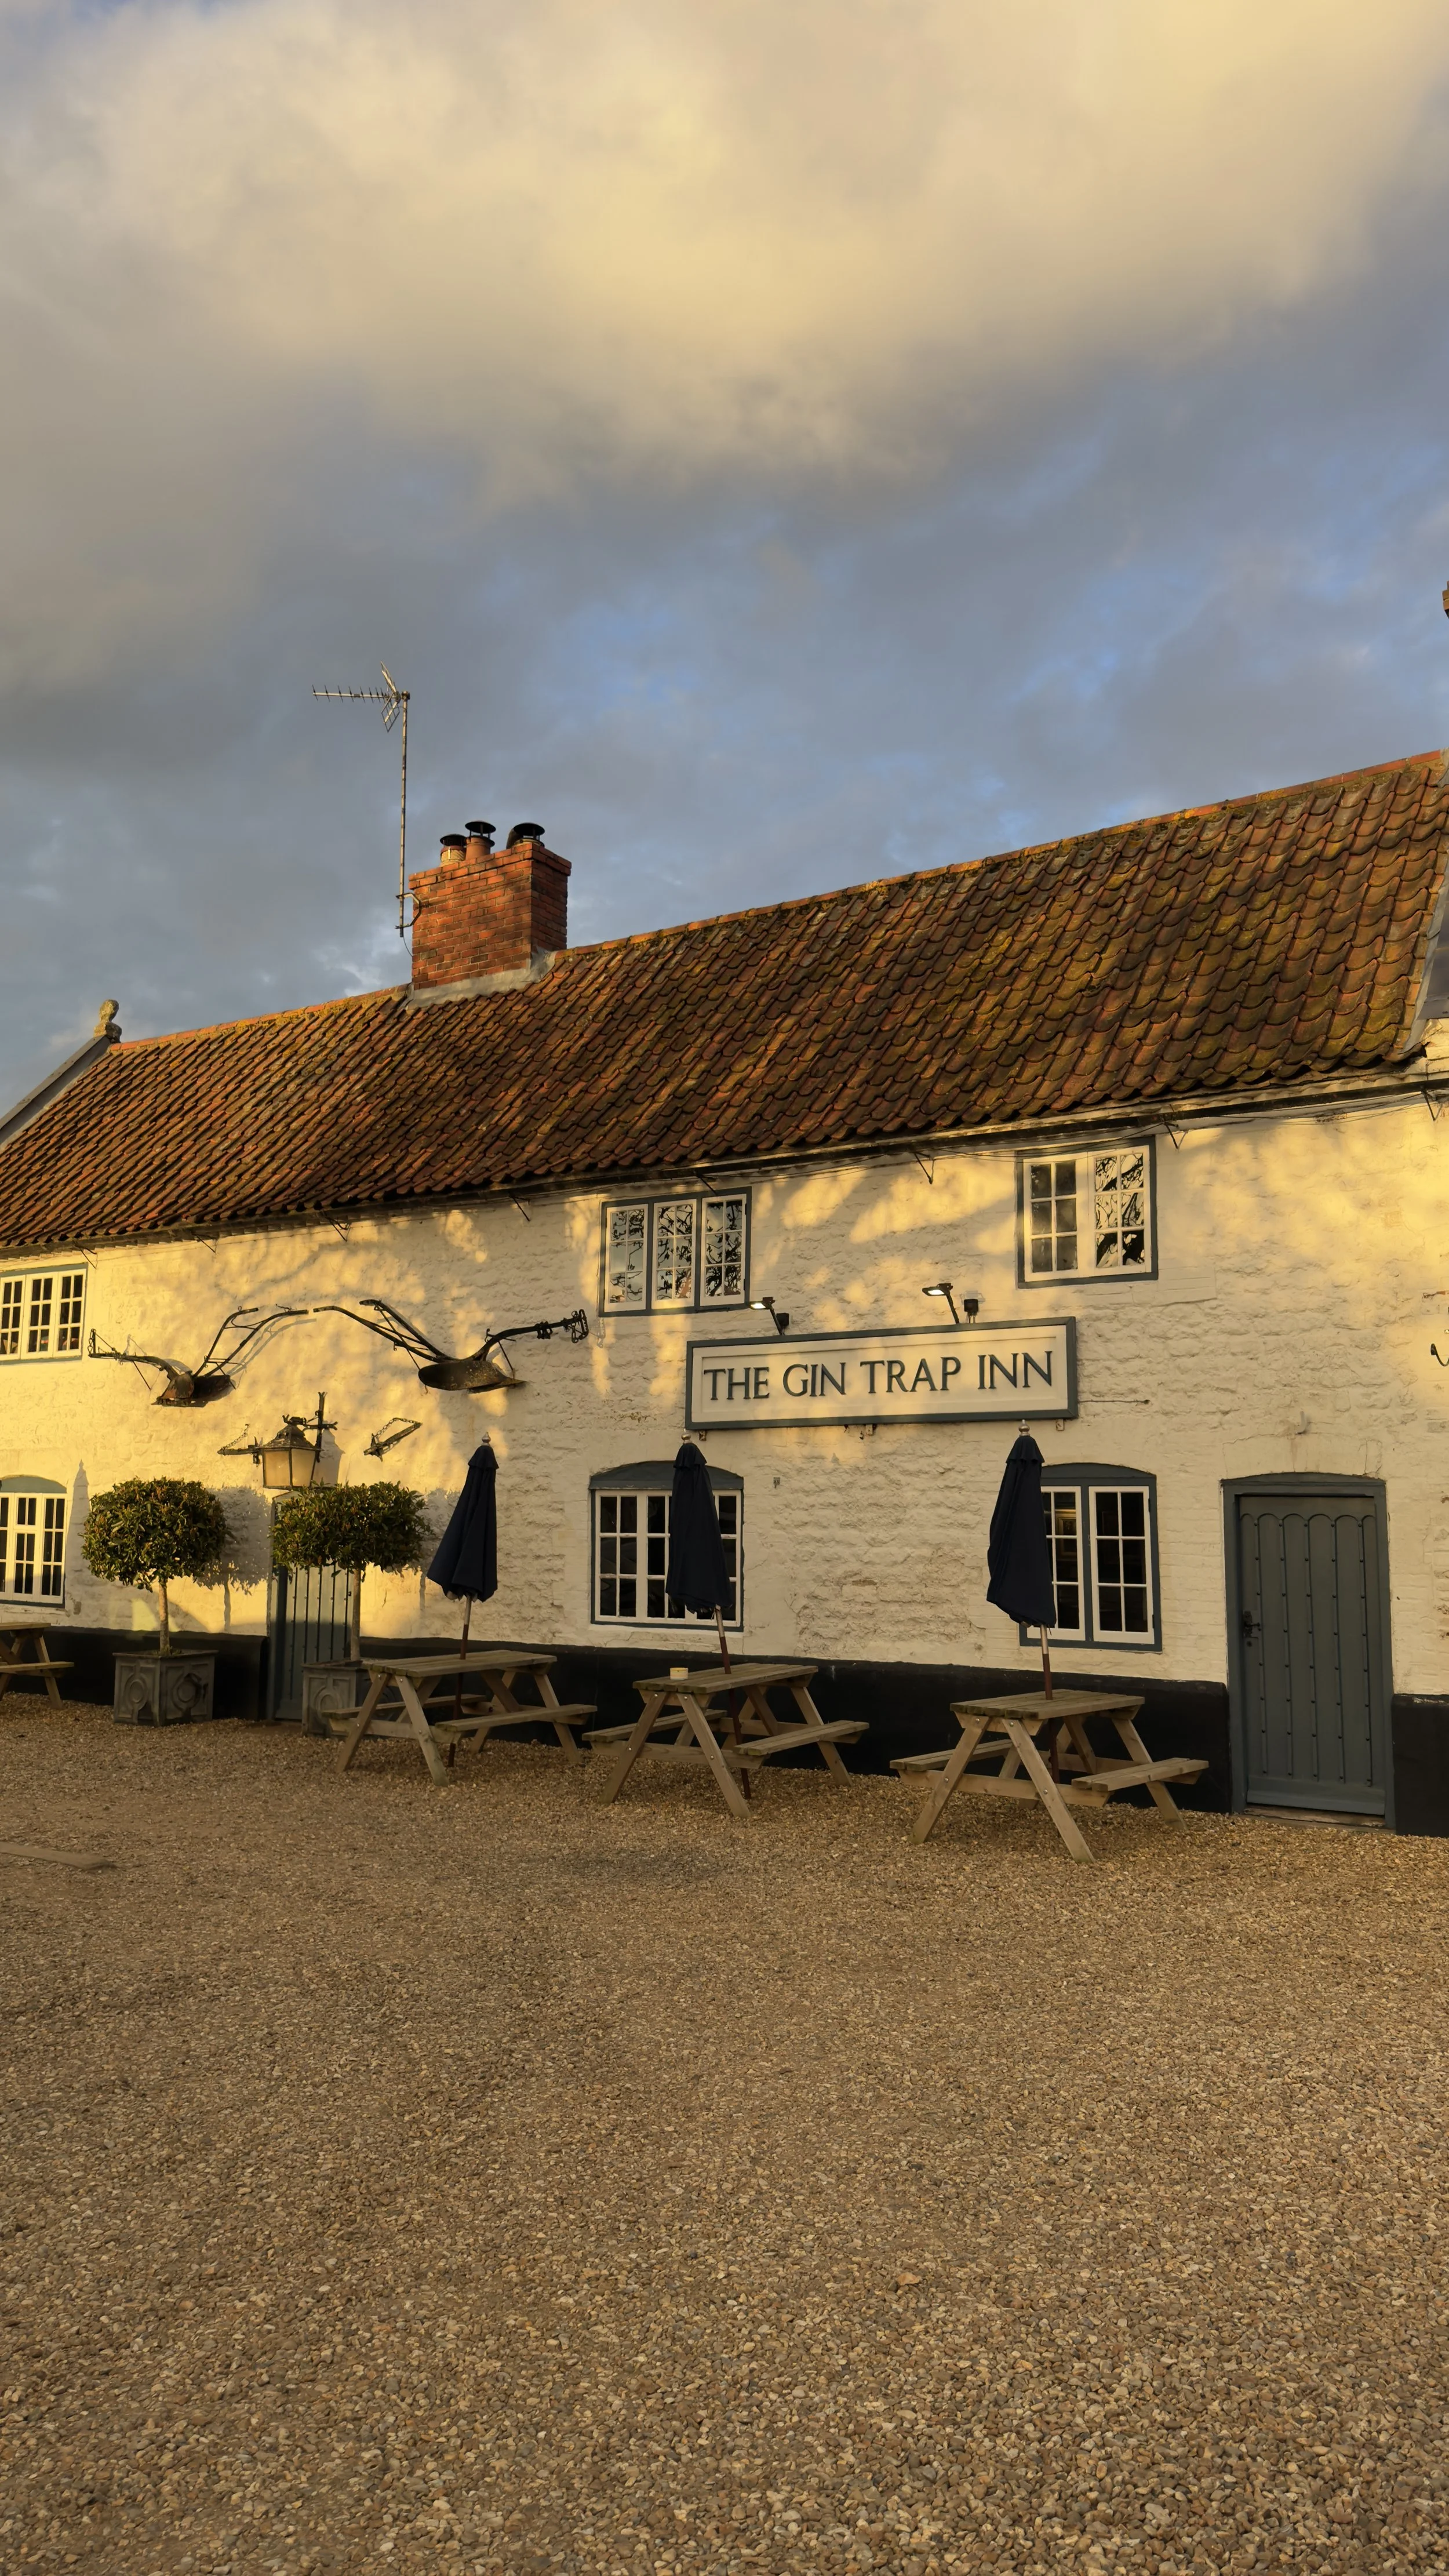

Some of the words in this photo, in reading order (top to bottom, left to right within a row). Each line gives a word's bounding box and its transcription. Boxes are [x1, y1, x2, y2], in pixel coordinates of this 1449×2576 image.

[703, 1367, 770, 1400] THE
[782, 1362, 846, 1397] GIN
[860, 1356, 961, 1394] TRAP
[978, 1351, 1053, 1389] INN
